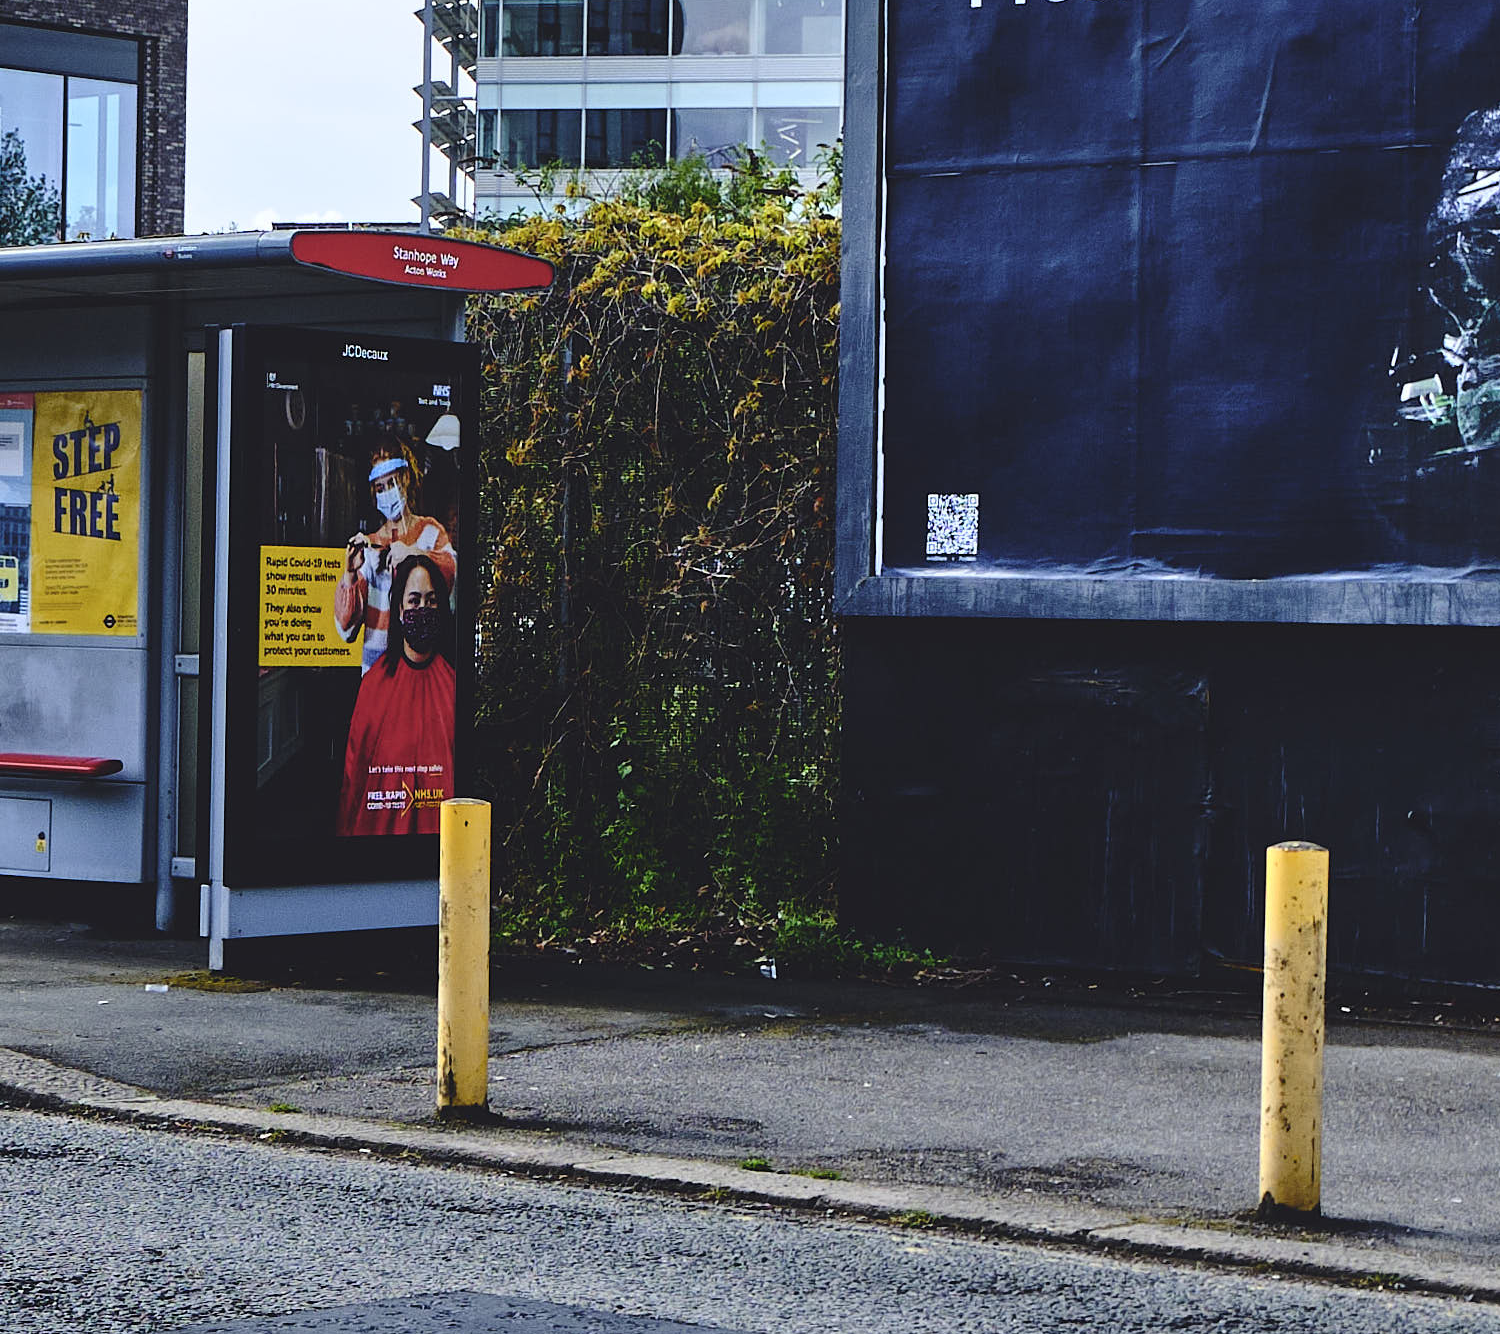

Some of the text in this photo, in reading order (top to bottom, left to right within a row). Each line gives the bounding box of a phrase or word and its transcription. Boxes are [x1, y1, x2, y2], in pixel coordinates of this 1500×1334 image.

[393, 246, 459, 269] Stanhope Way
[405, 264, 447, 279] Acton Works
[342, 344, 389, 361] JCDecaux
[433, 385, 451, 397] NHS
[53, 423, 121, 480] STEP
[54, 487, 121, 541] FREE
[266, 557, 341, 568] Rapid Covid-19 tests
[266, 572, 337, 582] show results within
[266, 585, 276, 595] 30
[265, 603, 322, 615] They also show
[264, 617, 312, 630] you're doing
[264, 631, 325, 643] what you can to
[264, 647, 292, 656] protect
[294, 647, 311, 657] your
[386, 790, 406, 800] RAPID
[414, 788, 444, 800] NHS.UK
